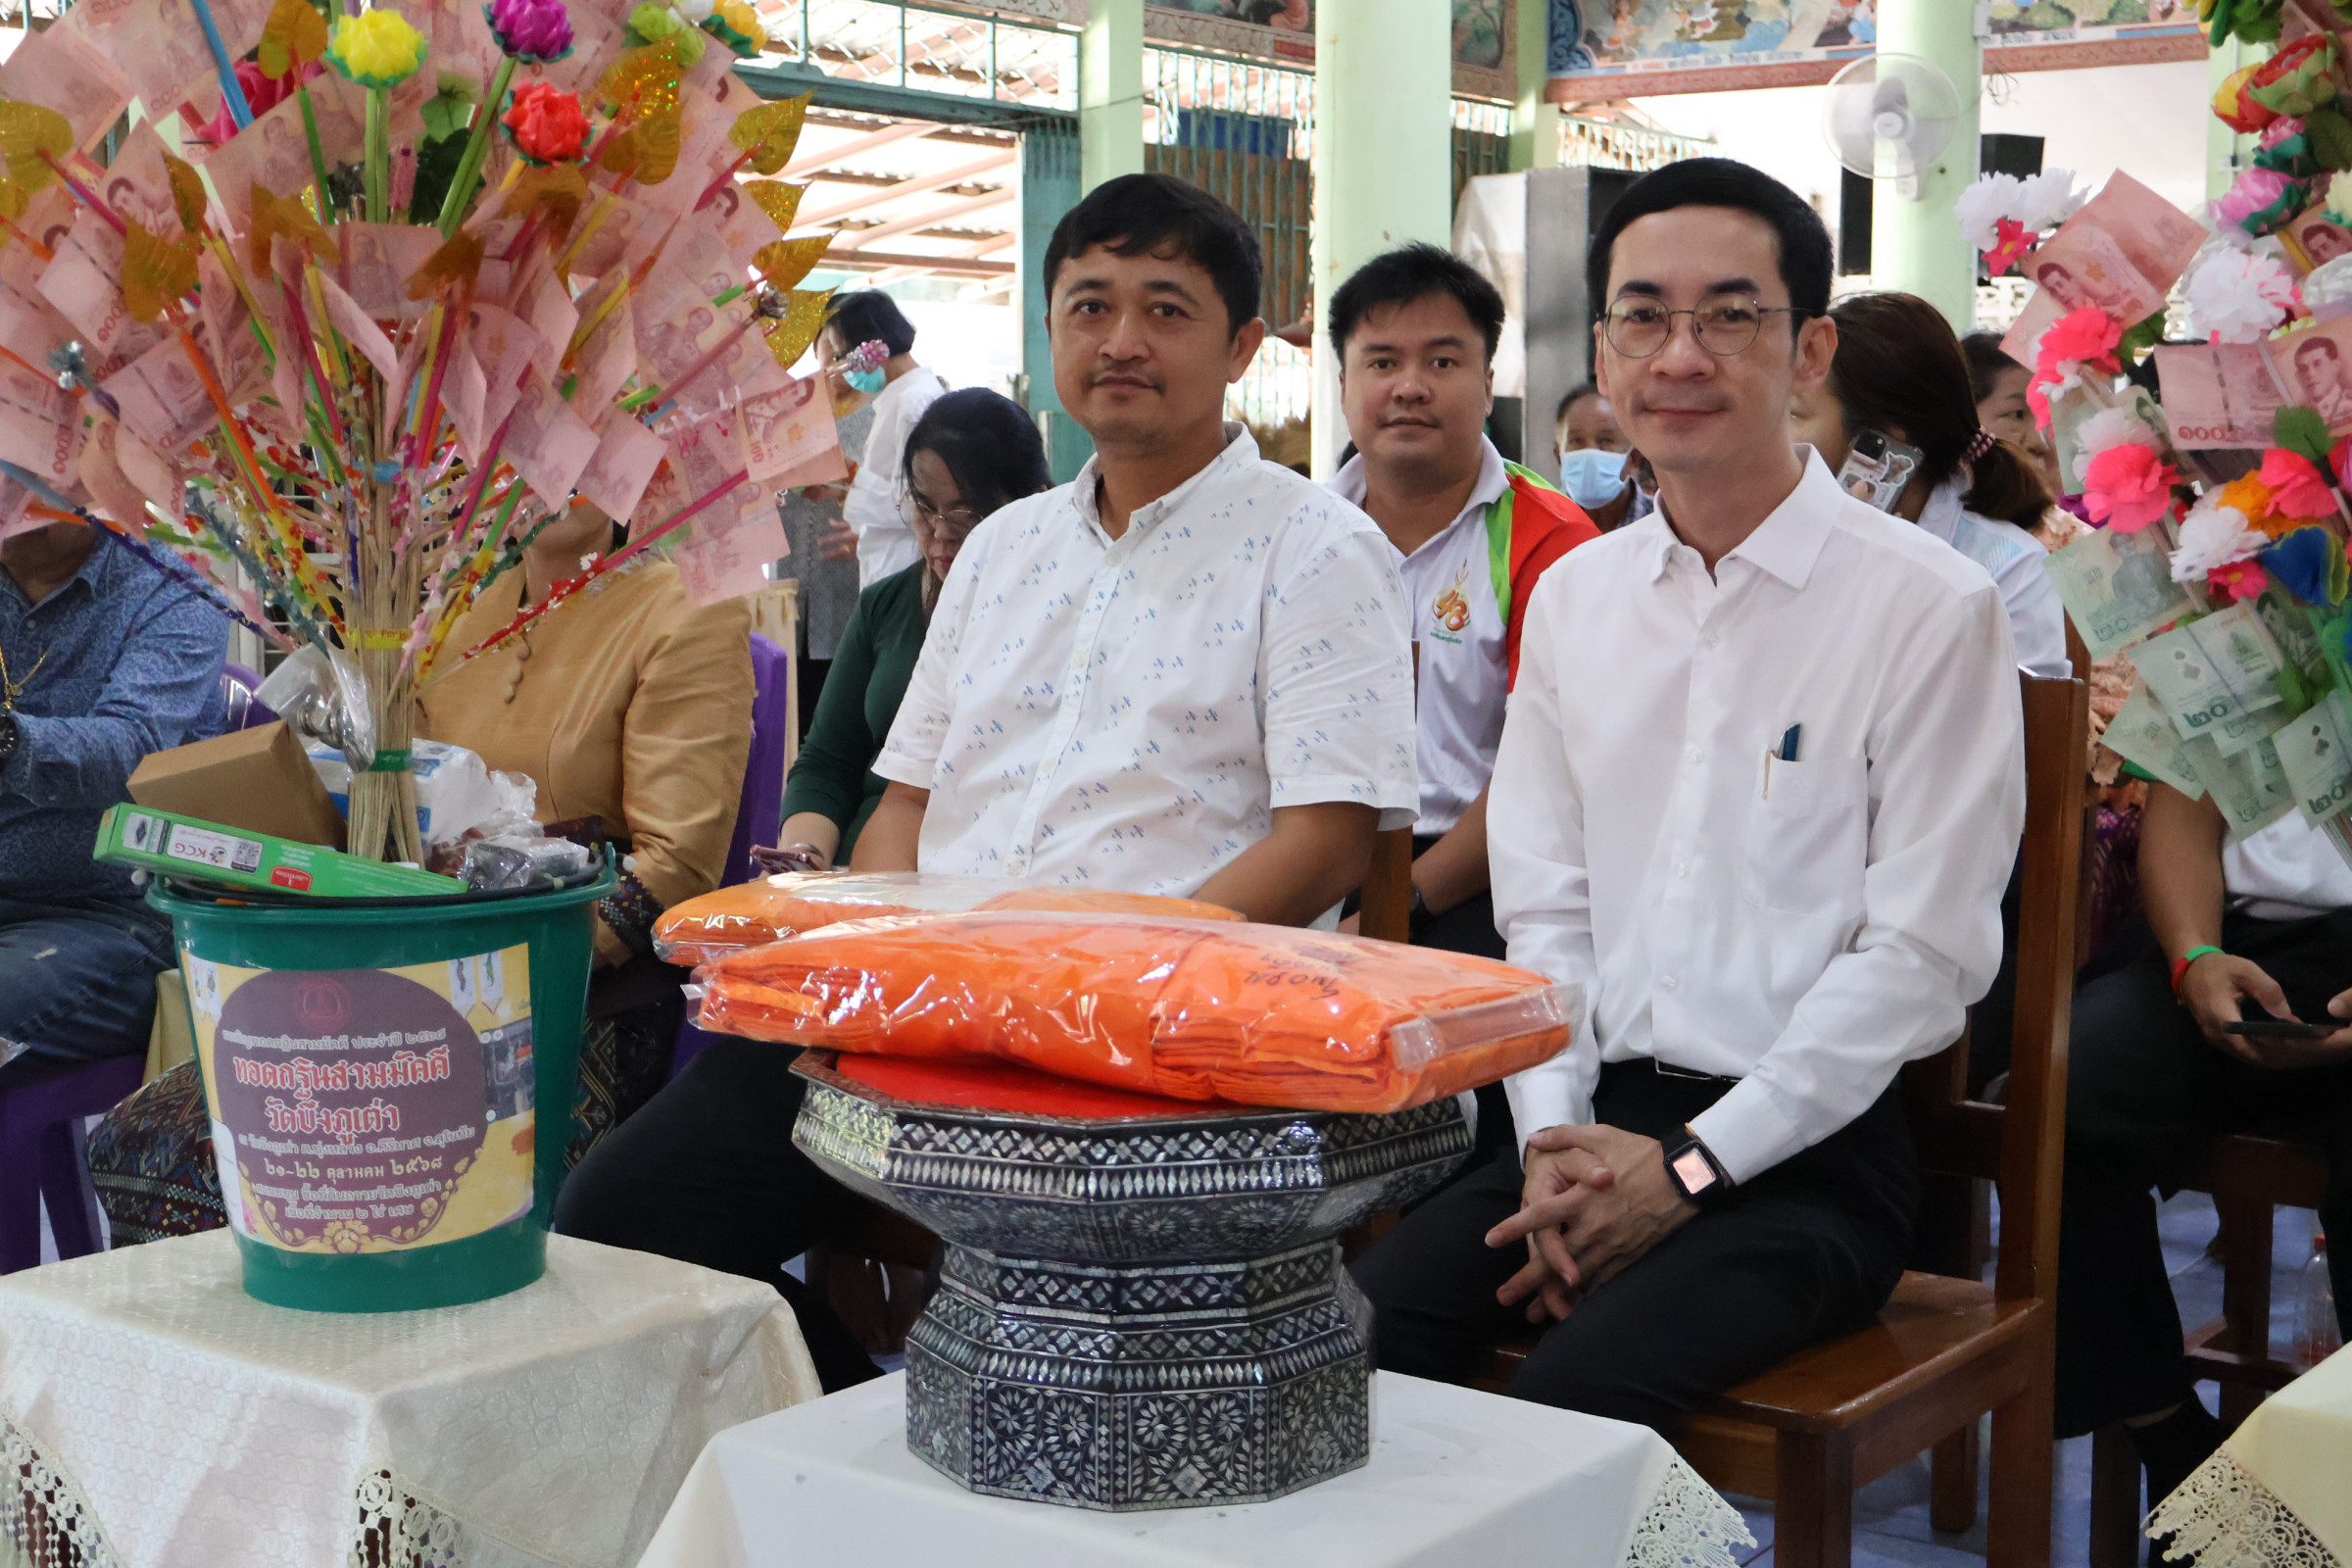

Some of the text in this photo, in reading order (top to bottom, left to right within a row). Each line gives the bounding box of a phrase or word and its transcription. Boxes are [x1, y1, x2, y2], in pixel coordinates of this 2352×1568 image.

[2178, 425, 2227, 441] ๑๐๐
[1436, 589, 1469, 632] 48
[2182, 703, 2230, 729] ๒๐
[2307, 784, 2347, 815] ๒๐
[174, 842, 208, 859] KCG
[351, 1031, 403, 1050] ประจำปี
[389, 1155, 443, 1176] ๒๕๖๘
